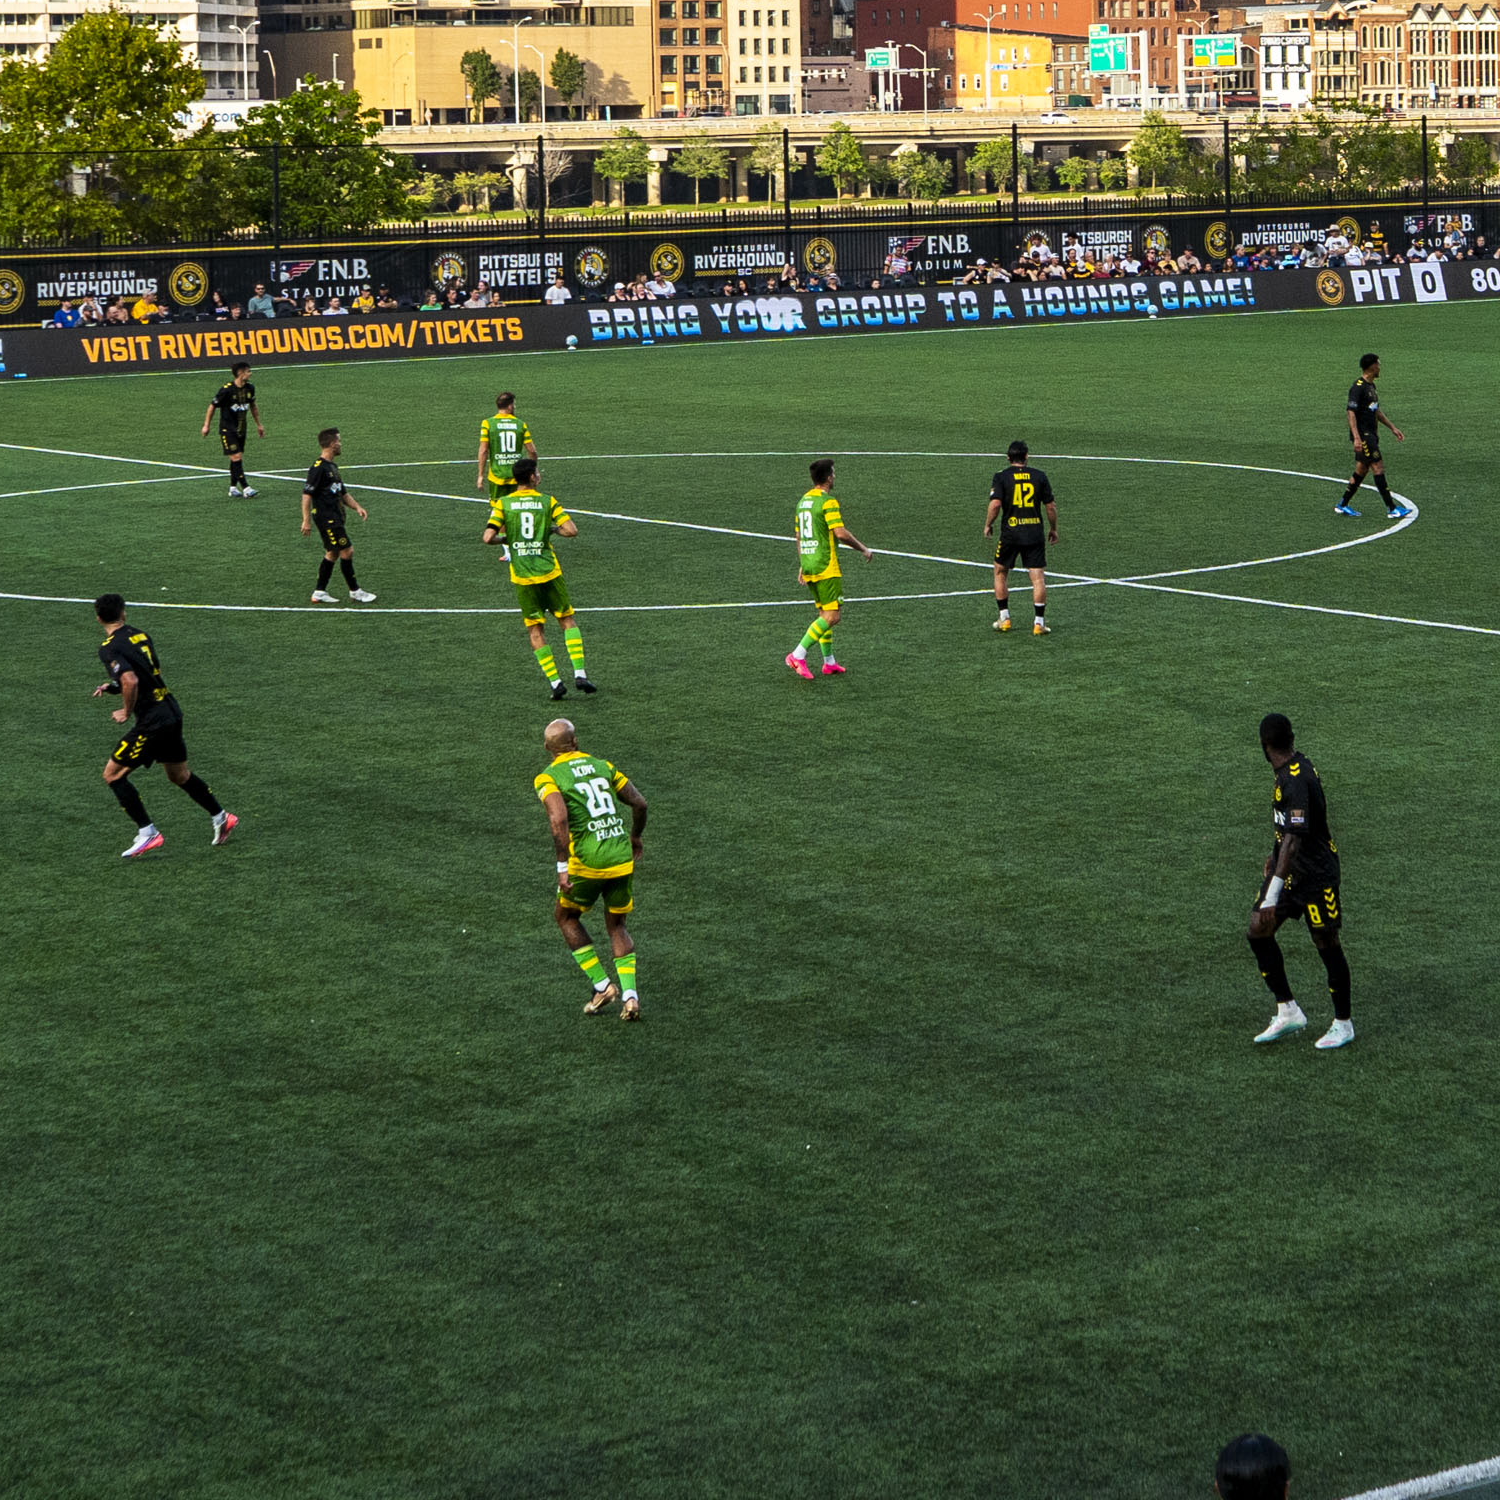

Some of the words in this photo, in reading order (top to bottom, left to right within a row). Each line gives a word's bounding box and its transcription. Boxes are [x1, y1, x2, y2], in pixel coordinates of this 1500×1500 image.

[1241, 228, 1326, 246] RIVERHOUNDS
[1257, 222, 1311, 231] PITTSBURGH
[712, 243, 776, 253] PITTSBURGH
[927, 234, 972, 254] F.N.B.
[59, 269, 136, 281] PITTSBURGH
[317, 258, 371, 281] F.N.B.
[737, 268, 753, 276] SC
[37, 278, 158, 299] RIVERHOUNDS
[281, 285, 360, 299] STADIUM
[1350, 267, 1401, 302] PIT
[587, 305, 702, 341] BRING
[815, 293, 927, 328] GROUP
[937, 290, 980, 322] TO
[992, 289, 1015, 320] A
[1021, 281, 1151, 318] HOUNDS
[1159, 277, 1256, 311] GAME!
[81, 335, 153, 363] VISIT
[159, 317, 524, 360] RIVERHOUNDS.COM/TICKETS
[498, 431, 517, 453] 10
[1012, 482, 1035, 508] 42
[520, 511, 535, 539] 8
[573, 777, 617, 818] 26
[1308, 903, 1322, 925] 8
